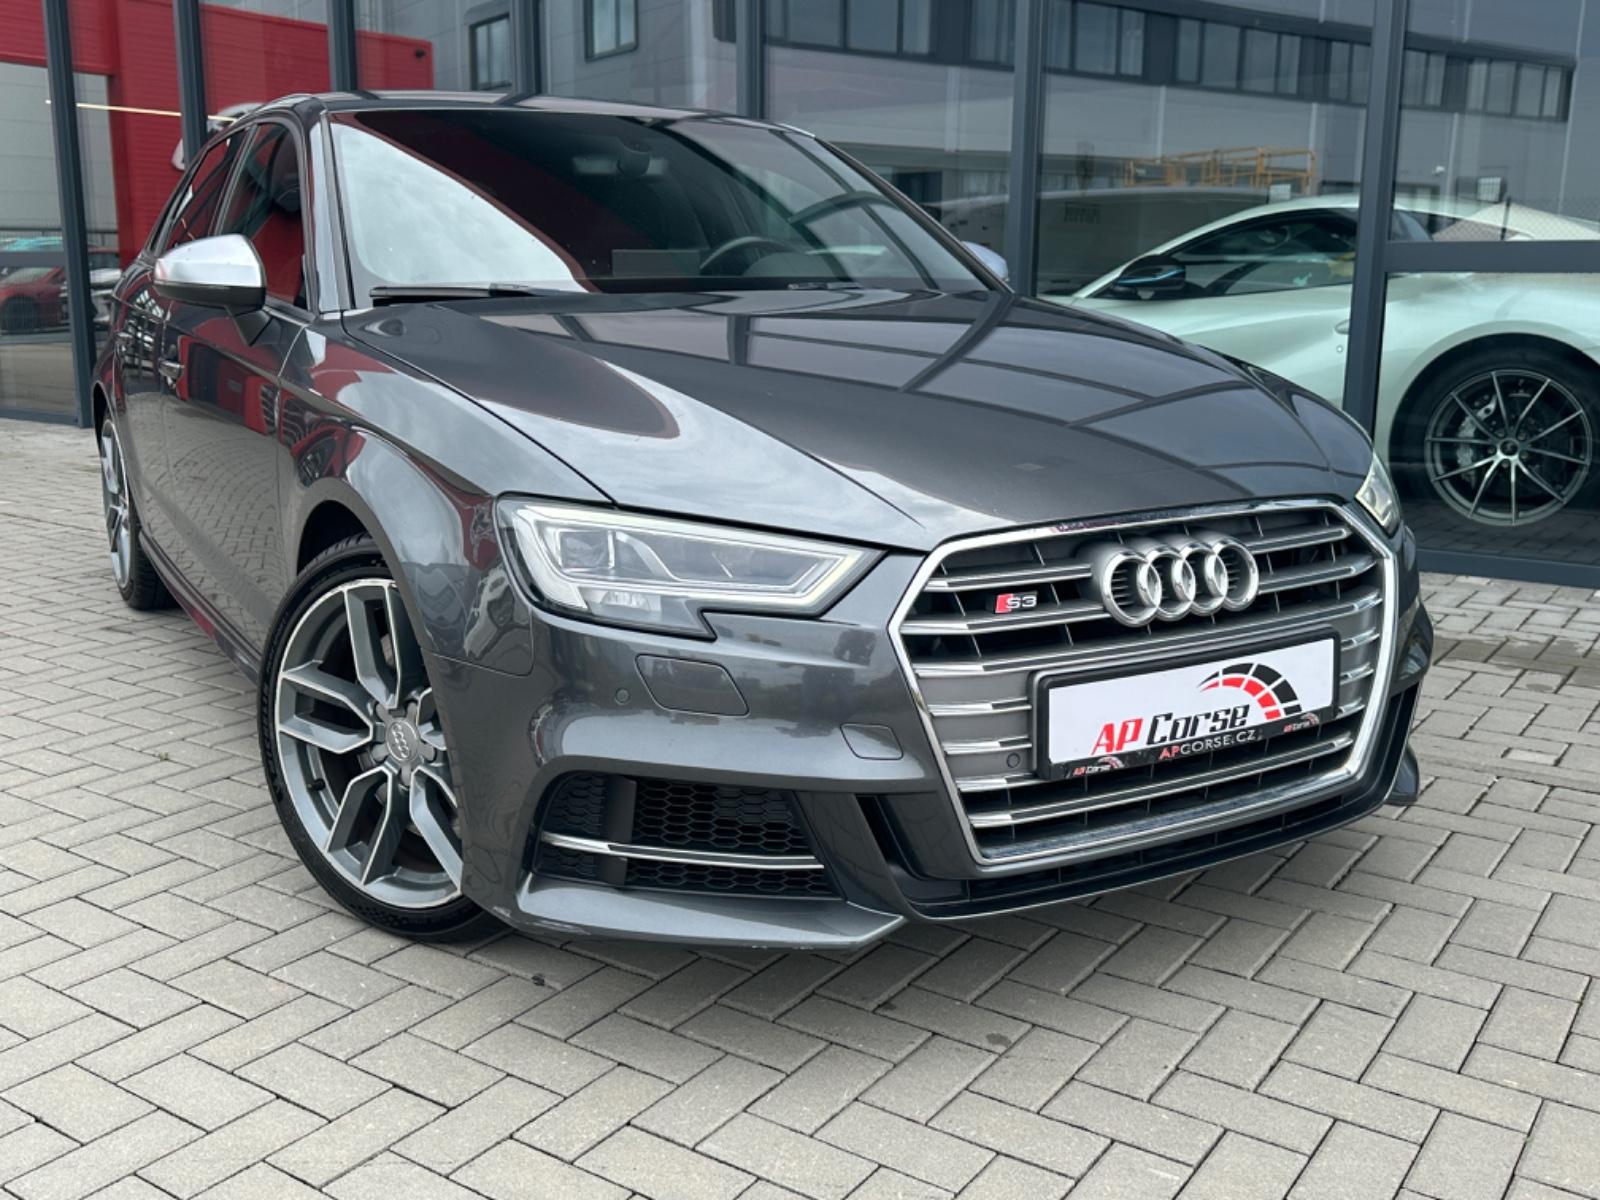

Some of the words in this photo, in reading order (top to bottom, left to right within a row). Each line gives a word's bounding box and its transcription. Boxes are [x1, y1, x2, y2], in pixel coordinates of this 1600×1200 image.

[1004, 594, 1037, 609] S3
[1090, 718, 1143, 756] AP
[1146, 704, 1250, 746] Corse
[1158, 729, 1257, 760] APCORSE.CZ
